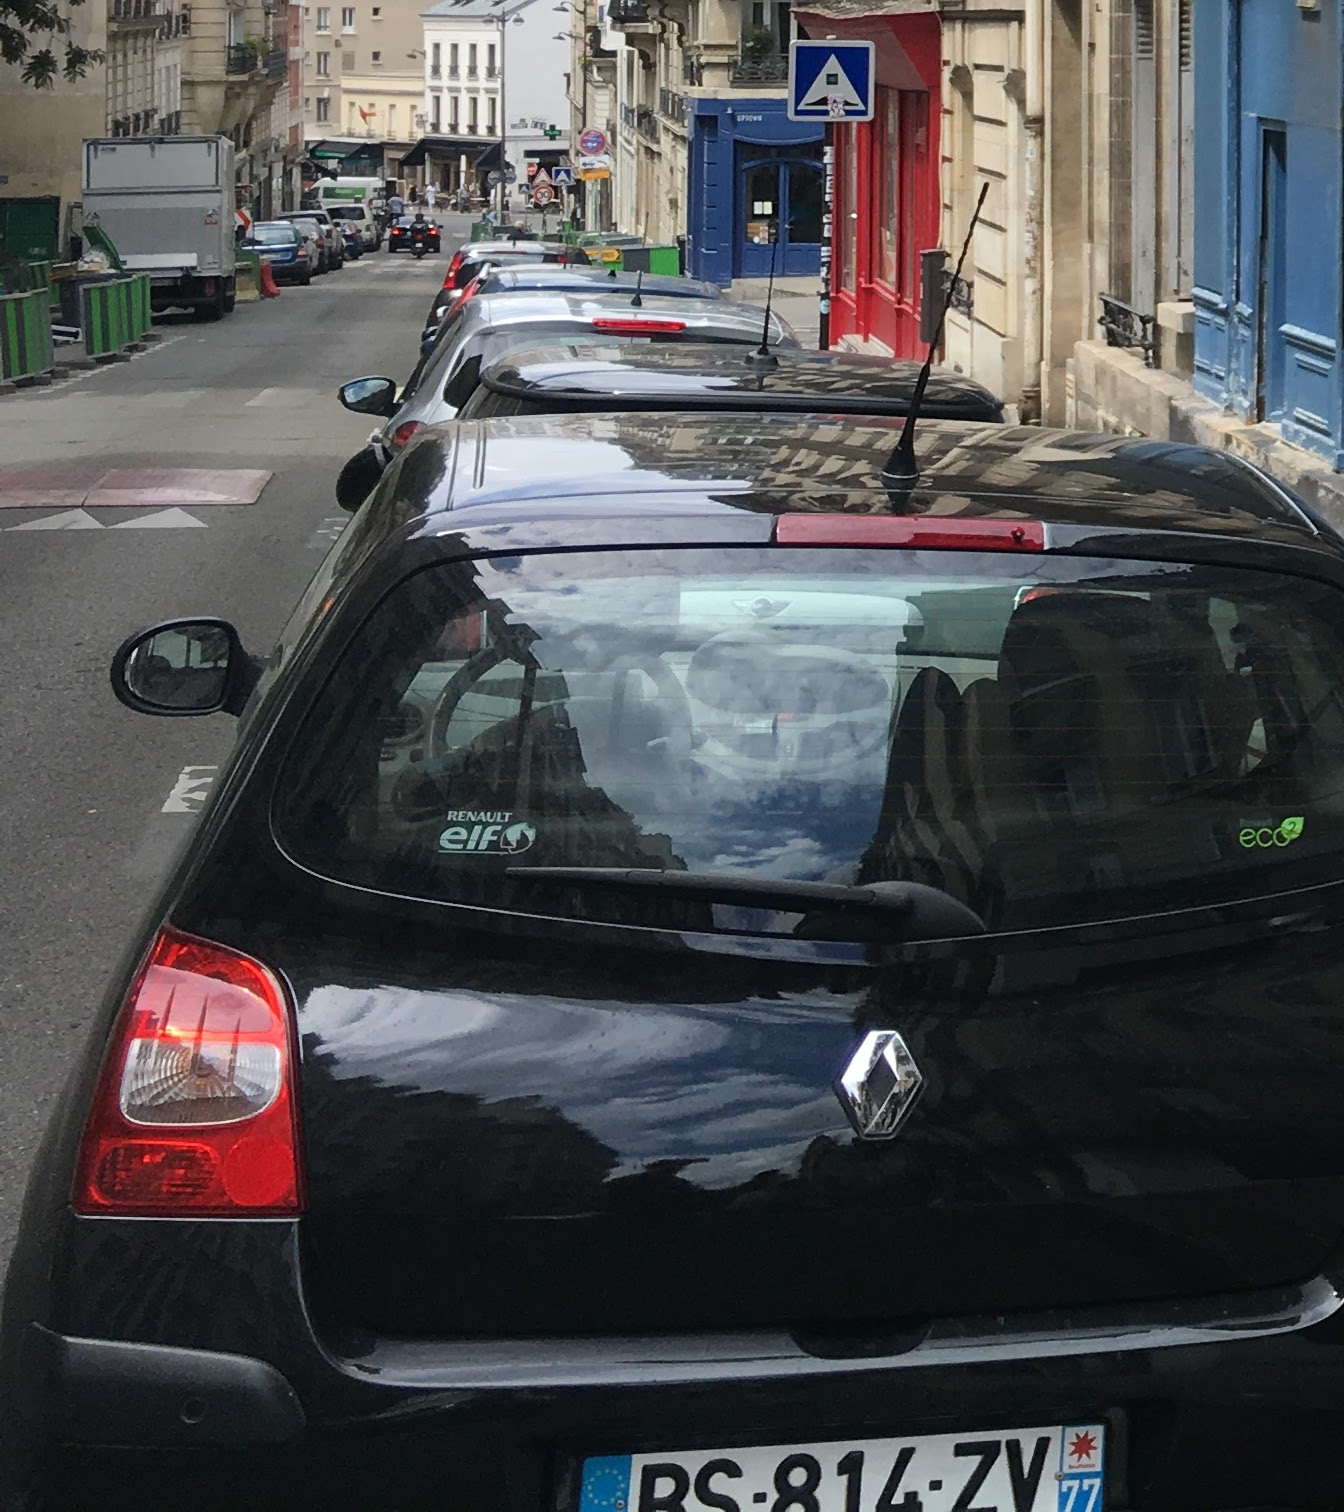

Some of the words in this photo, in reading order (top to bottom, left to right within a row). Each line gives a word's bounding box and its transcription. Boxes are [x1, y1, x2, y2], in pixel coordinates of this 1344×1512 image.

[447, 810, 514, 823] RENAULT
[438, 823, 503, 851] elf
[1061, 1478, 1101, 1512] 77
